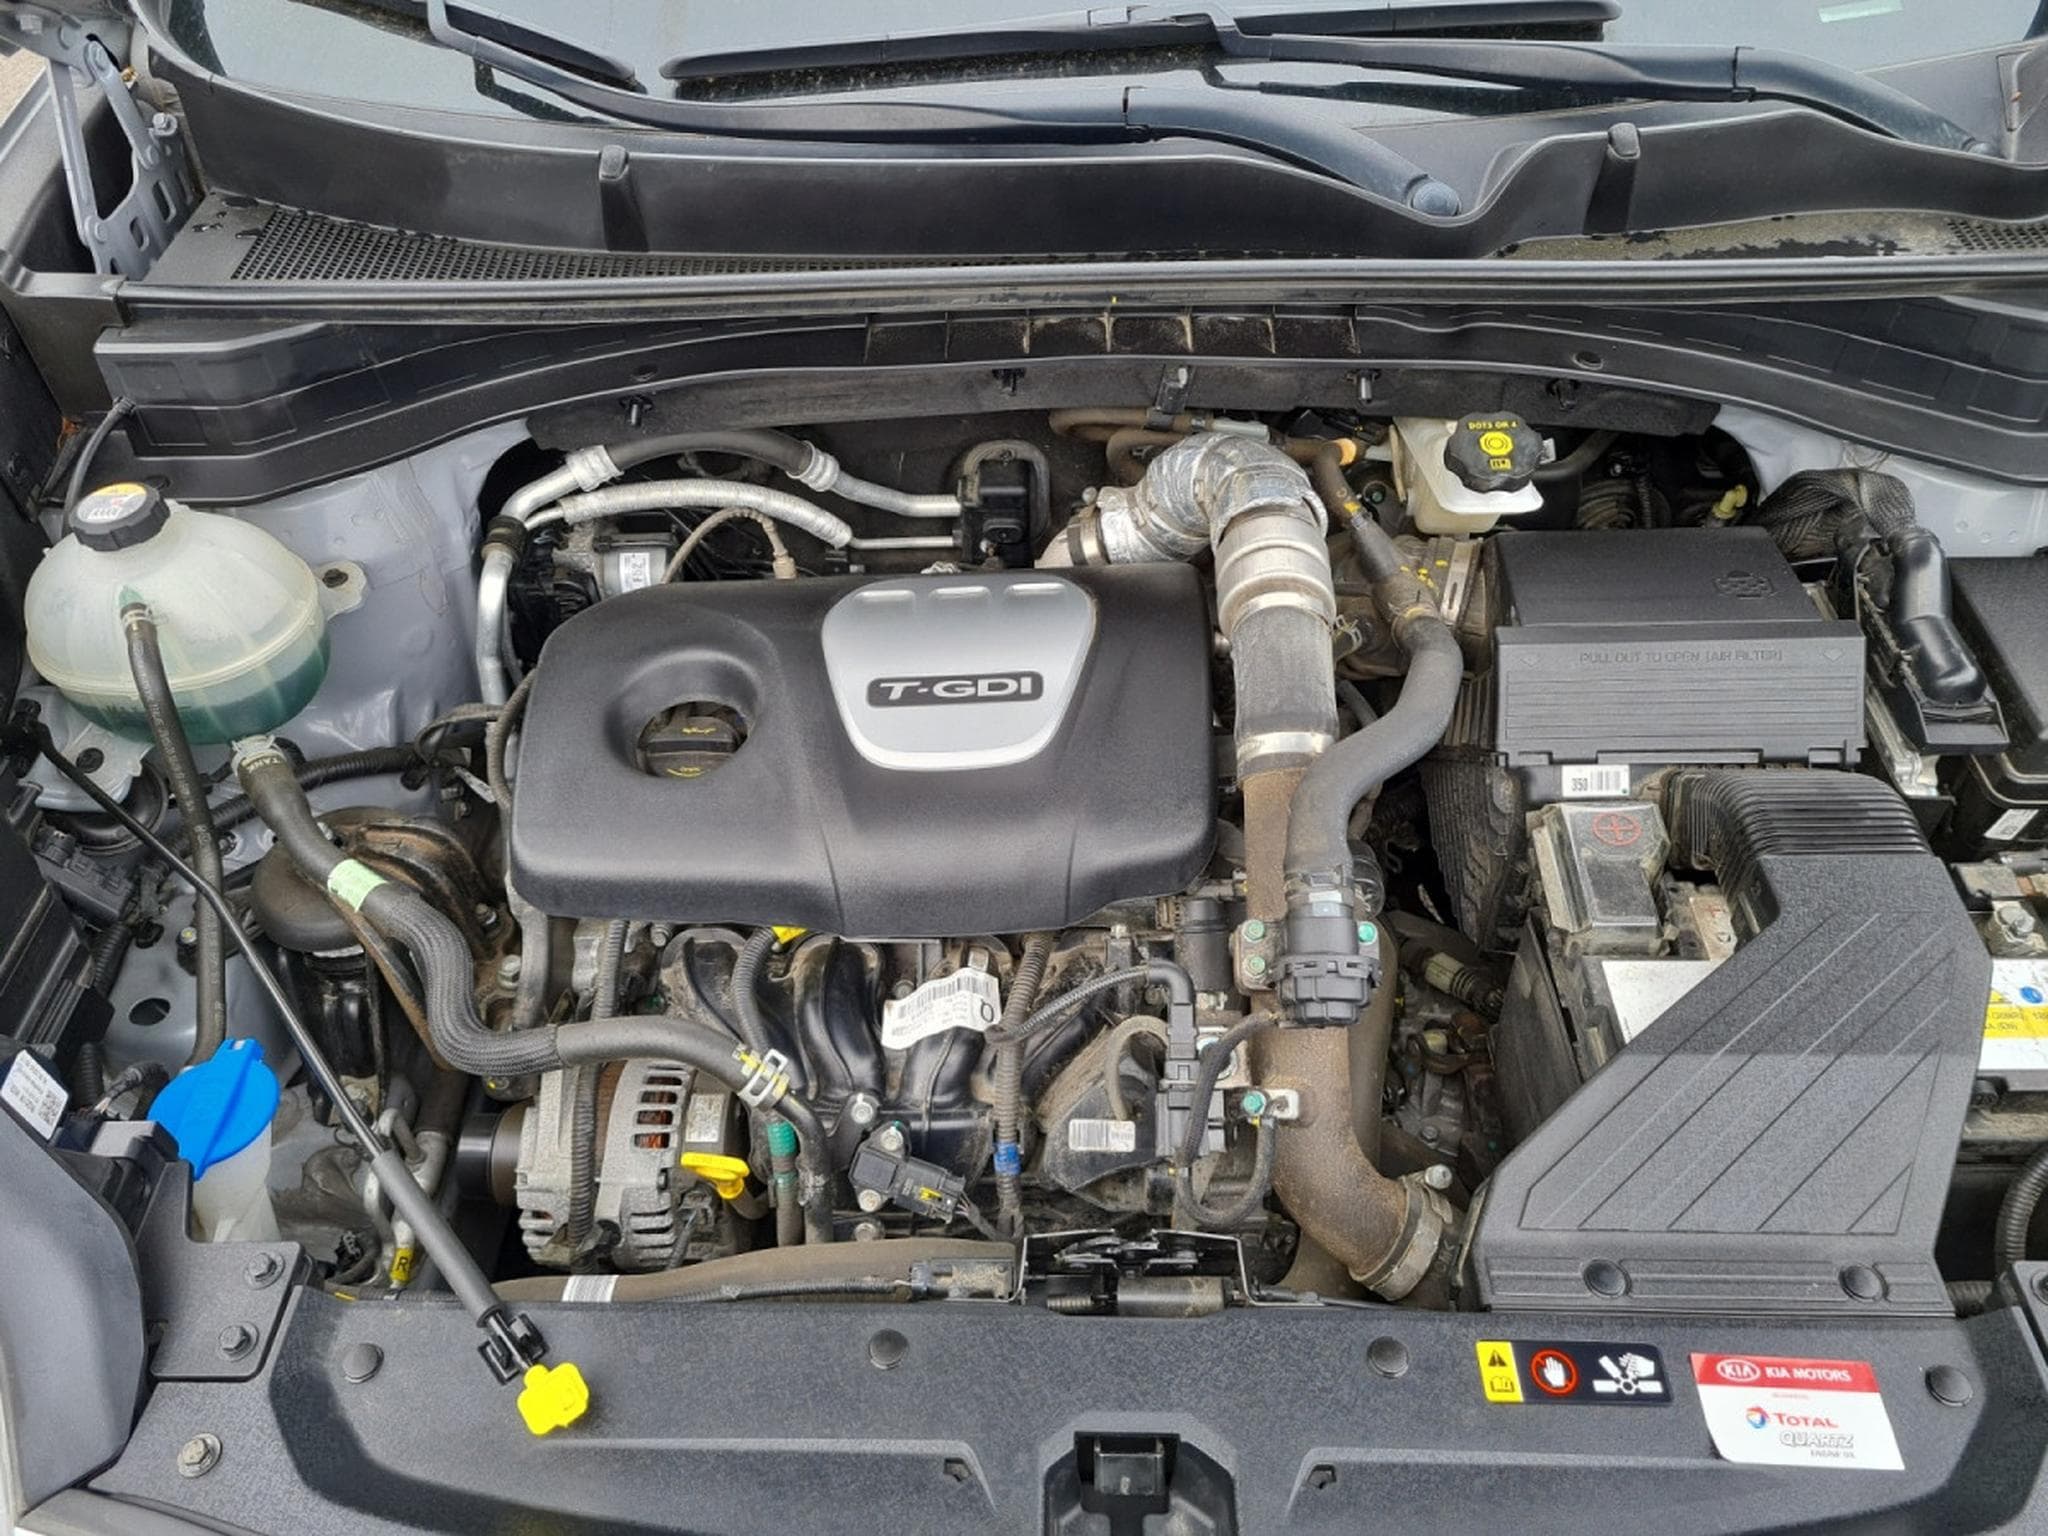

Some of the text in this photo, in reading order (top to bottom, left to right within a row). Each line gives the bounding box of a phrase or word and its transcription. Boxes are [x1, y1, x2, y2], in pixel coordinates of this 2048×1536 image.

[1579, 652, 1612, 664] PULL
[1615, 651, 1641, 664] OUT
[1645, 651, 1662, 663] TO
[1665, 650, 1699, 663] OPEN
[880, 677, 1032, 700] T-GDI
[1723, 1361, 1756, 1379] KIA
[1765, 1366, 1852, 1382] KIA MOTORS
[1773, 1412, 1839, 1428] TOTAL
[1780, 1430, 1854, 1449] QUARTZ
